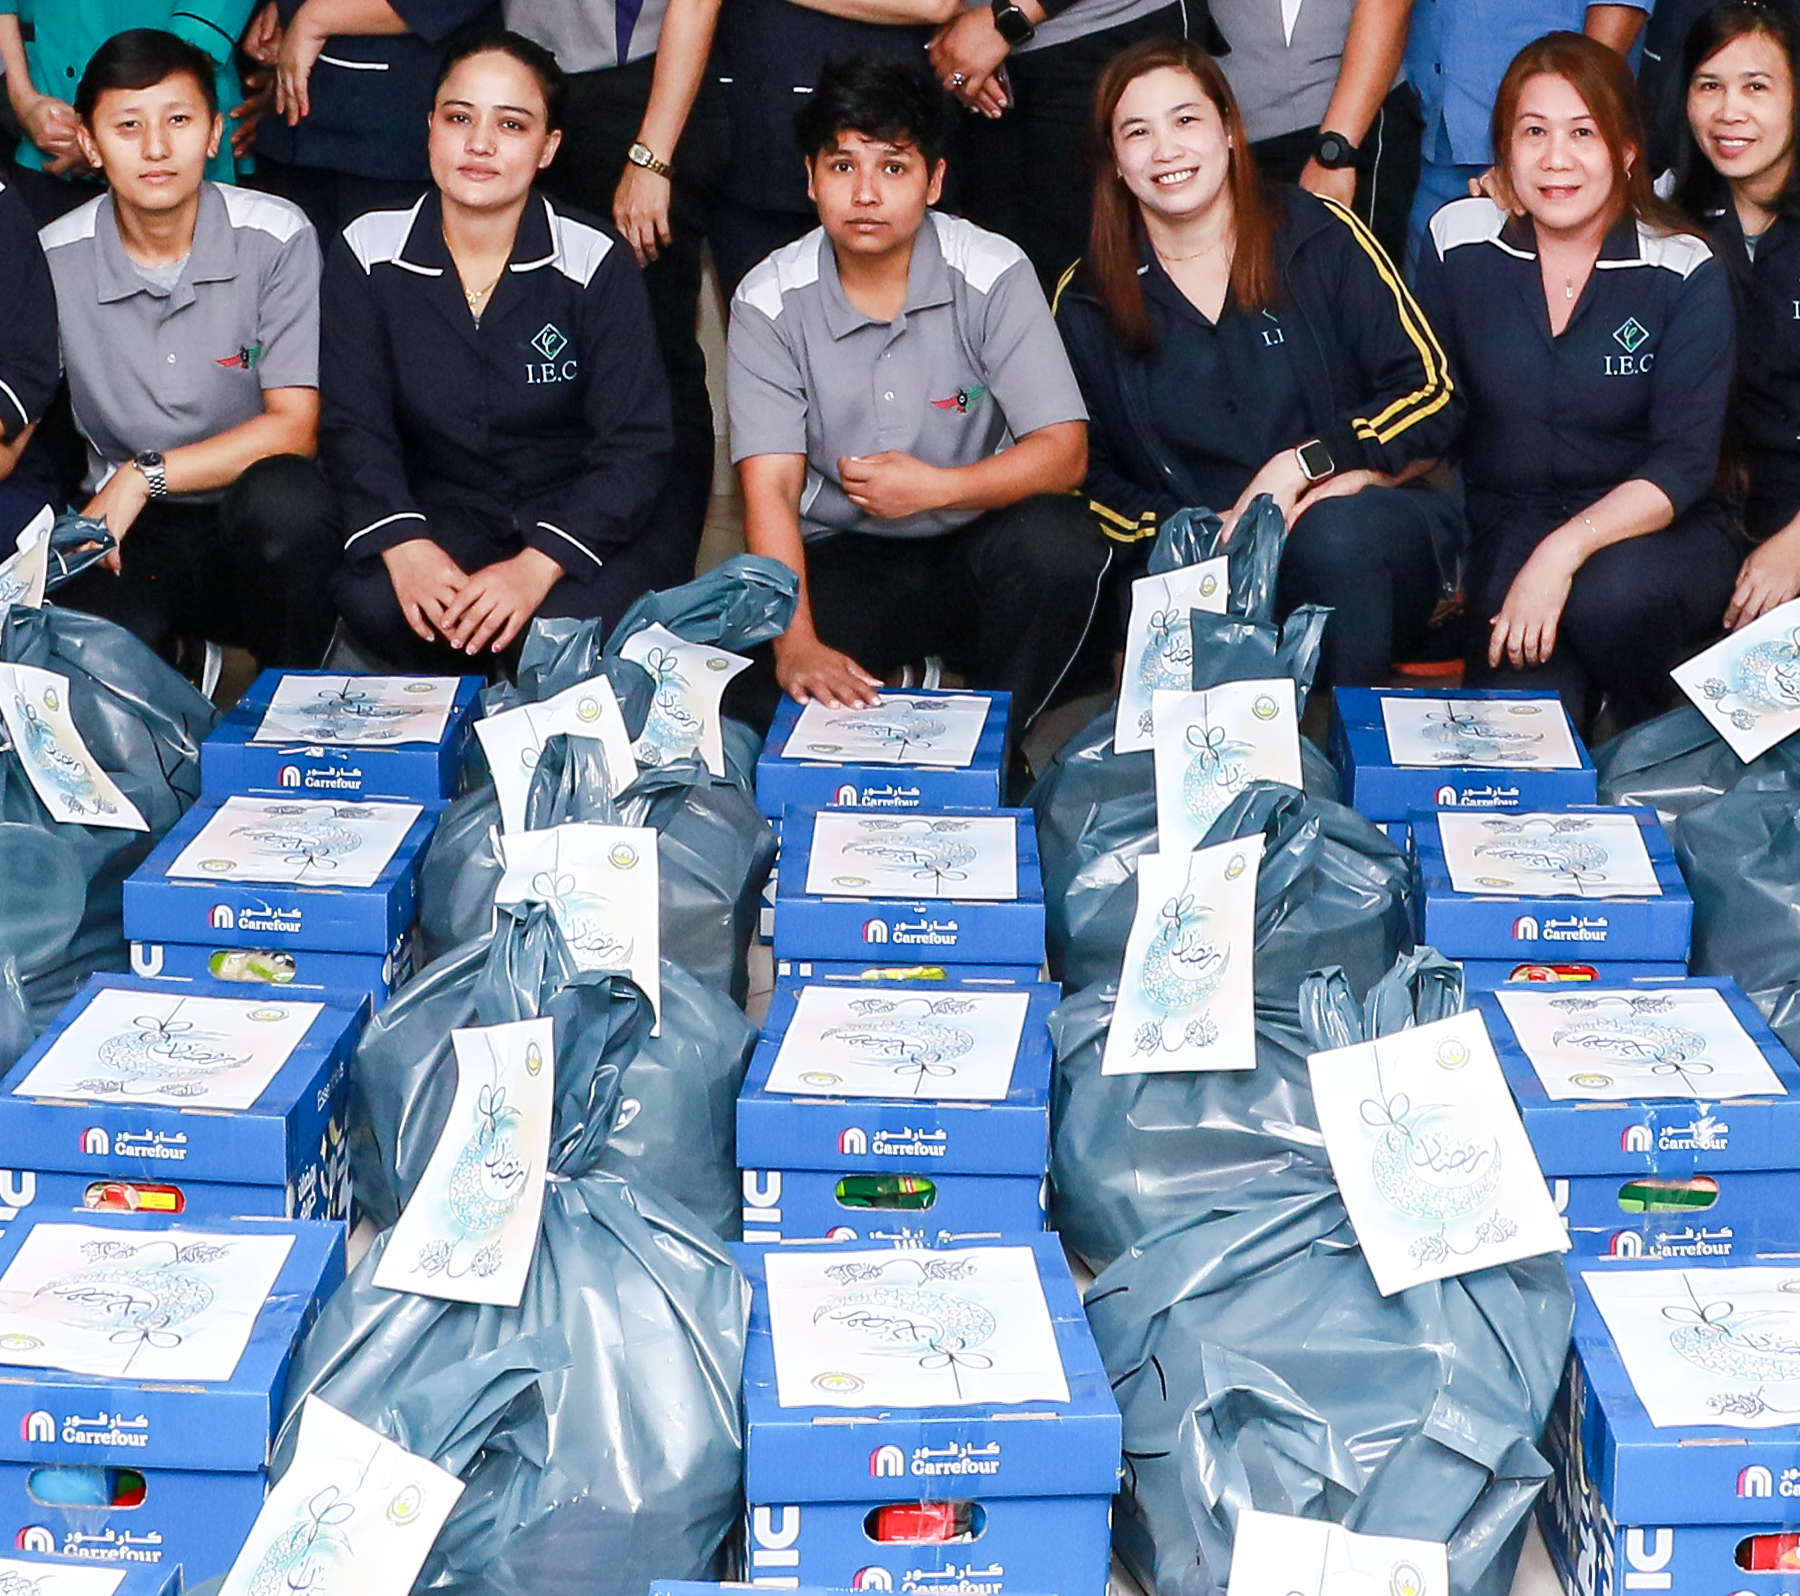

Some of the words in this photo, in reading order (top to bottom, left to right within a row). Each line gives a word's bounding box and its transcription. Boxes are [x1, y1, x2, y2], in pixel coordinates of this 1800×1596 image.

[304, 777, 361, 789] Carrefour
[239, 906, 301, 918] كارفور
[238, 917, 301, 932] Carrefour
[893, 919, 957, 931] كارفور
[1544, 916, 1608, 928] كارفور
[892, 931, 957, 945] Carrefour
[1543, 928, 1607, 941] Carrefour
[116, 1129, 188, 1144] كارفور
[873, 1127, 946, 1140] كارفور
[114, 1143, 187, 1160] Carrefour
[872, 1141, 946, 1156] Carrefour
[1654, 1227, 1733, 1241] كارفور
[62, 1412, 149, 1428] كارفور
[62, 1427, 149, 1446] Carrefour
[912, 1441, 1000, 1459] كارفور
[911, 1458, 1000, 1476] Carrefour
[64, 1528, 162, 1545] كارفور
[903, 1563, 1004, 1581] كارفور
